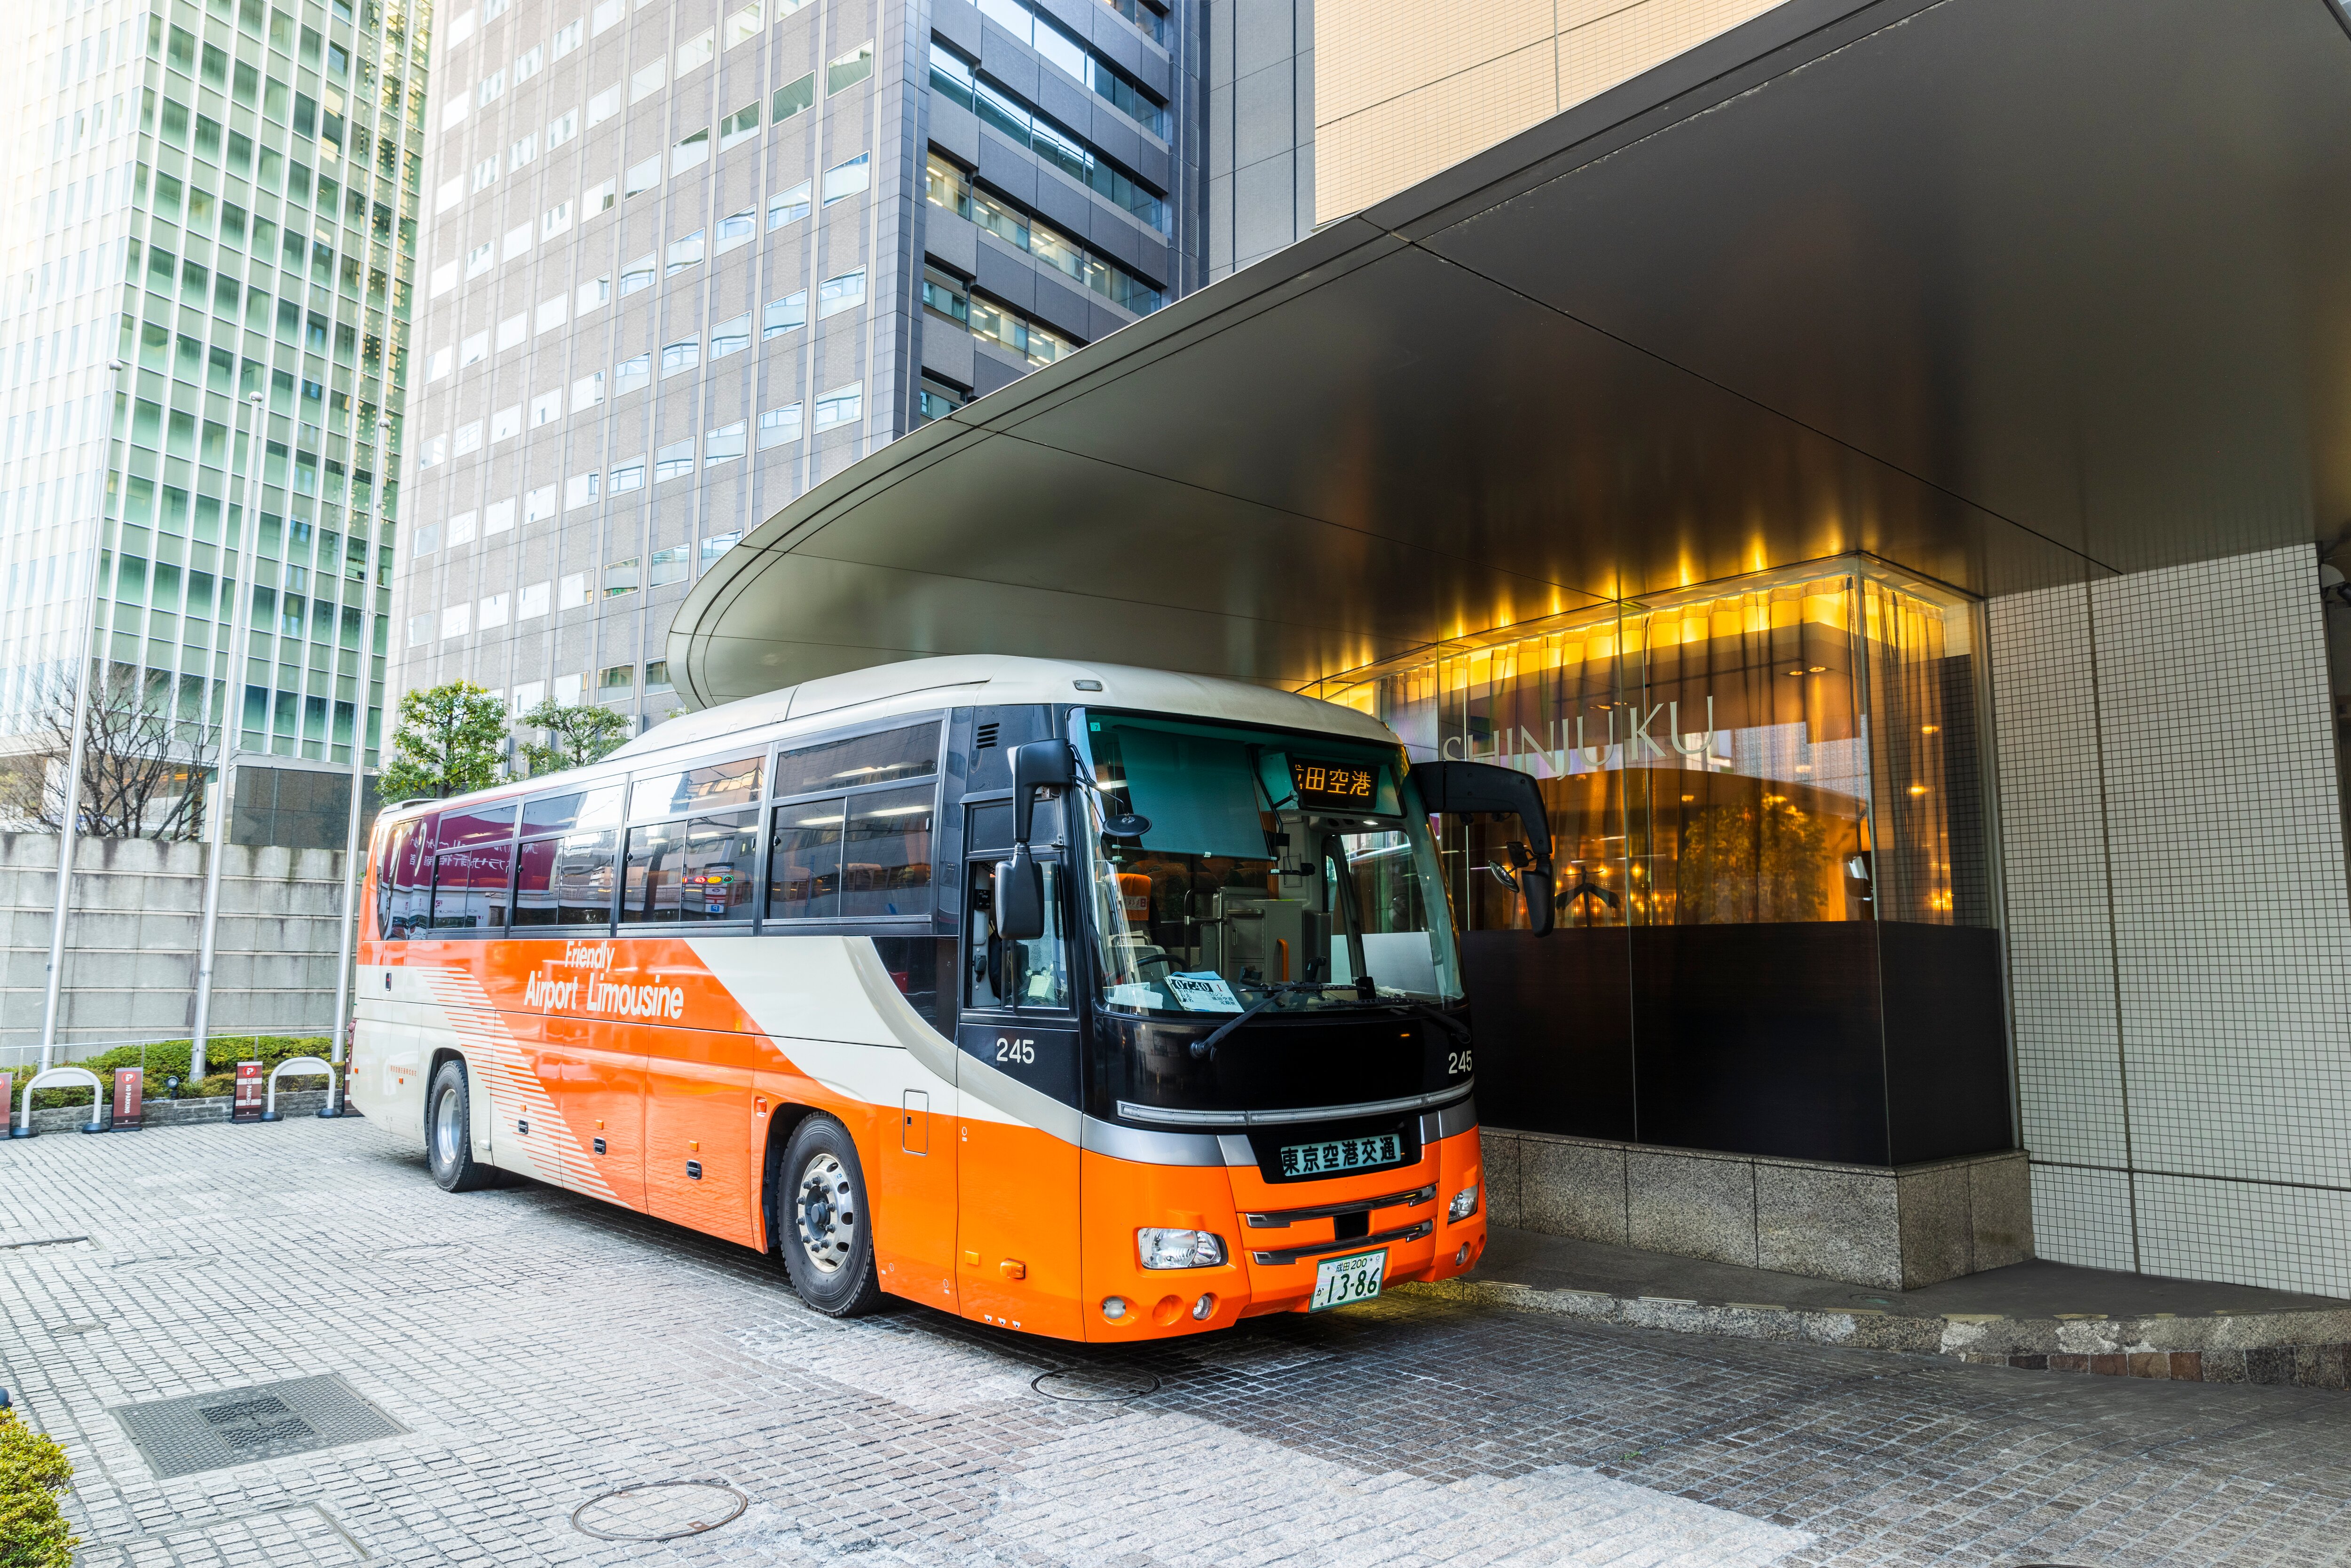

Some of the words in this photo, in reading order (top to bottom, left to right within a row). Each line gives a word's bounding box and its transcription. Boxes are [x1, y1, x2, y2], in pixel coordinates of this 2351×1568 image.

[1443, 696, 1713, 780] SHINJUKU
[565, 940, 615, 972] Friendly
[524, 970, 578, 1014] Airport
[586, 972, 684, 1019] Limousine
[1175, 980, 1209, 992] 07:40
[996, 1038, 1034, 1064] 245
[1448, 1050, 1472, 1074] 245
[1281, 1136, 1396, 1174] 東京空港交通
[1336, 1262, 1350, 1273] 成田
[1350, 1258, 1367, 1270] 200
[1317, 1288, 1324, 1296] か
[1327, 1267, 1380, 1303] 13-86
